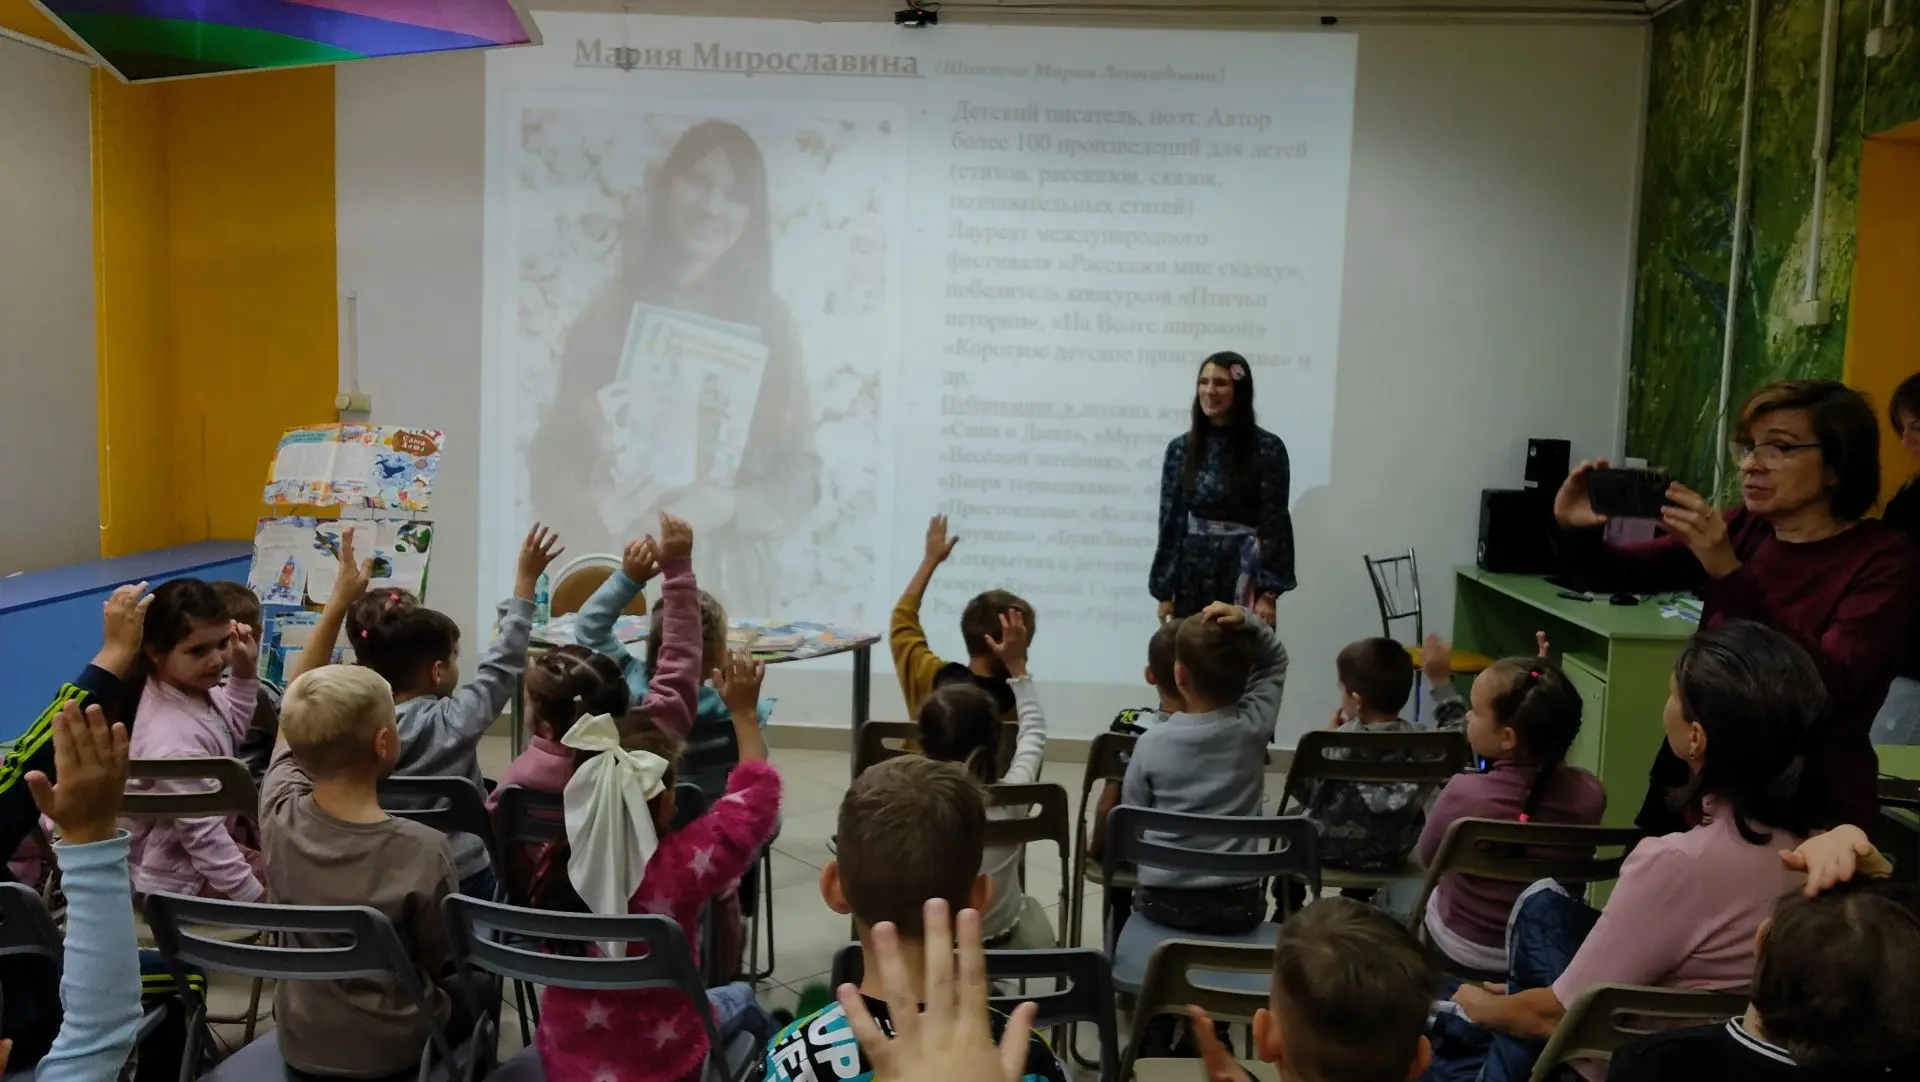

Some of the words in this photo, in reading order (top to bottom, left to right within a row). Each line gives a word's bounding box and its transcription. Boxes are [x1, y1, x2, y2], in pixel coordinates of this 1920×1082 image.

[693, 41, 919, 77] Мирославина
[952, 100, 1038, 125] Детский
[1045, 108, 1144, 128] писатель,
[1207, 109, 1273, 133] Автор
[950, 130, 1009, 152] более
[1016, 133, 1052, 153] 100
[1057, 137, 1200, 159] произведений
[1206, 142, 1243, 160] для
[1249, 139, 1308, 160] детей
[1037, 167, 1145, 187] рассказов,
[1150, 170, 1223, 189] сказок,
[950, 195, 1113, 214] познавательных
[947, 219, 1028, 246] Лауреат
[1036, 226, 1209, 249] международного
[946, 250, 1052, 273] фестиваля
[1057, 254, 1167, 275] «Расскажи
[1172, 261, 1213, 277] мне
[944, 278, 1061, 300] победитель
[1066, 285, 1172, 309] конкурсов
[1178, 286, 1269, 309] «Птичьи
[1051, 312, 1090, 333] «На
[1097, 313, 1156, 335] Волге
[941, 336, 1050, 364] «Короткое
[1053, 345, 1134, 362] детское
